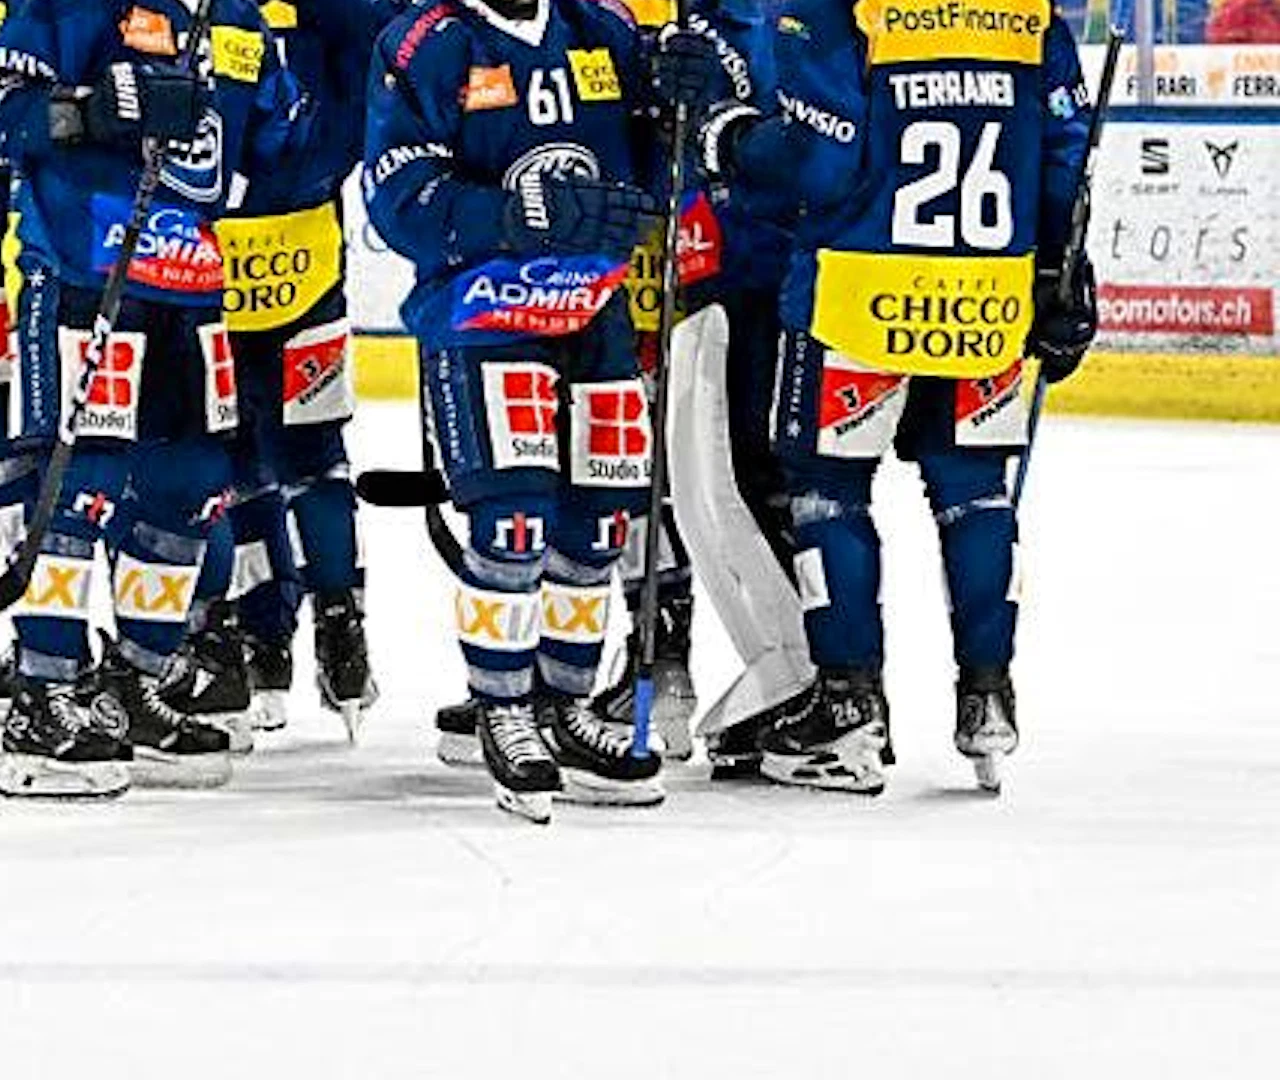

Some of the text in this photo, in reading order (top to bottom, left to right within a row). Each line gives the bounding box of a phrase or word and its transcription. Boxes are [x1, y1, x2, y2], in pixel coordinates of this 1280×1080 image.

[886, 3, 1042, 35] PostFinance
[527, 67, 574, 125] 61
[891, 120, 1014, 251] 26
[462, 268, 612, 309] ADMIRA
[869, 293, 1020, 324] CHICCO
[885, 329, 1004, 358] D'ORO
